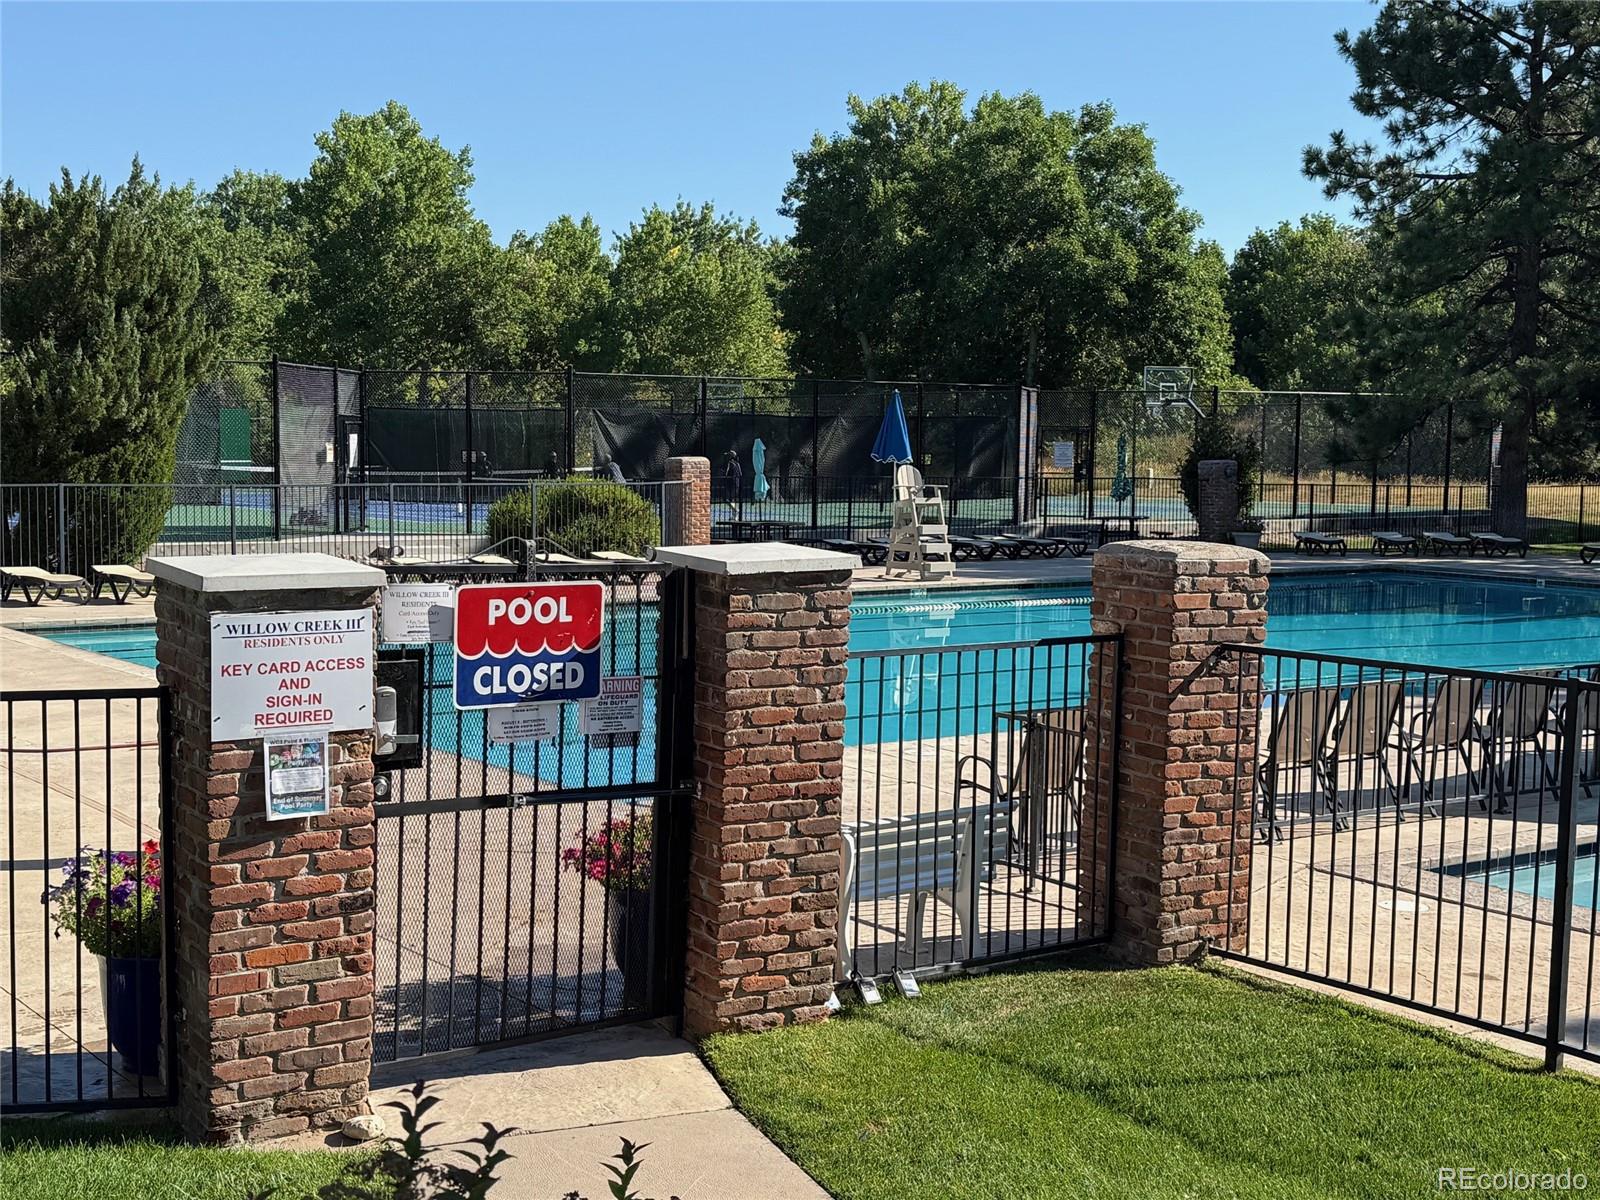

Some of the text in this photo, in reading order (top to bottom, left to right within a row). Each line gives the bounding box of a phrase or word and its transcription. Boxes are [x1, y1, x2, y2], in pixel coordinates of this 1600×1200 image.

[488, 596, 573, 626] POOL
[226, 618, 361, 636] WILLOW CREEK III
[244, 634, 345, 649] RESIDENTS ONLY
[221, 657, 365, 678] KEY CARD ACCESS
[278, 677, 311, 691] AND
[472, 661, 585, 696] CLOSED
[602, 679, 640, 693] ARNING
[266, 692, 322, 708] SIGN-IN
[254, 709, 333, 727] REQUIRED
[295, 801, 313, 809] Party
